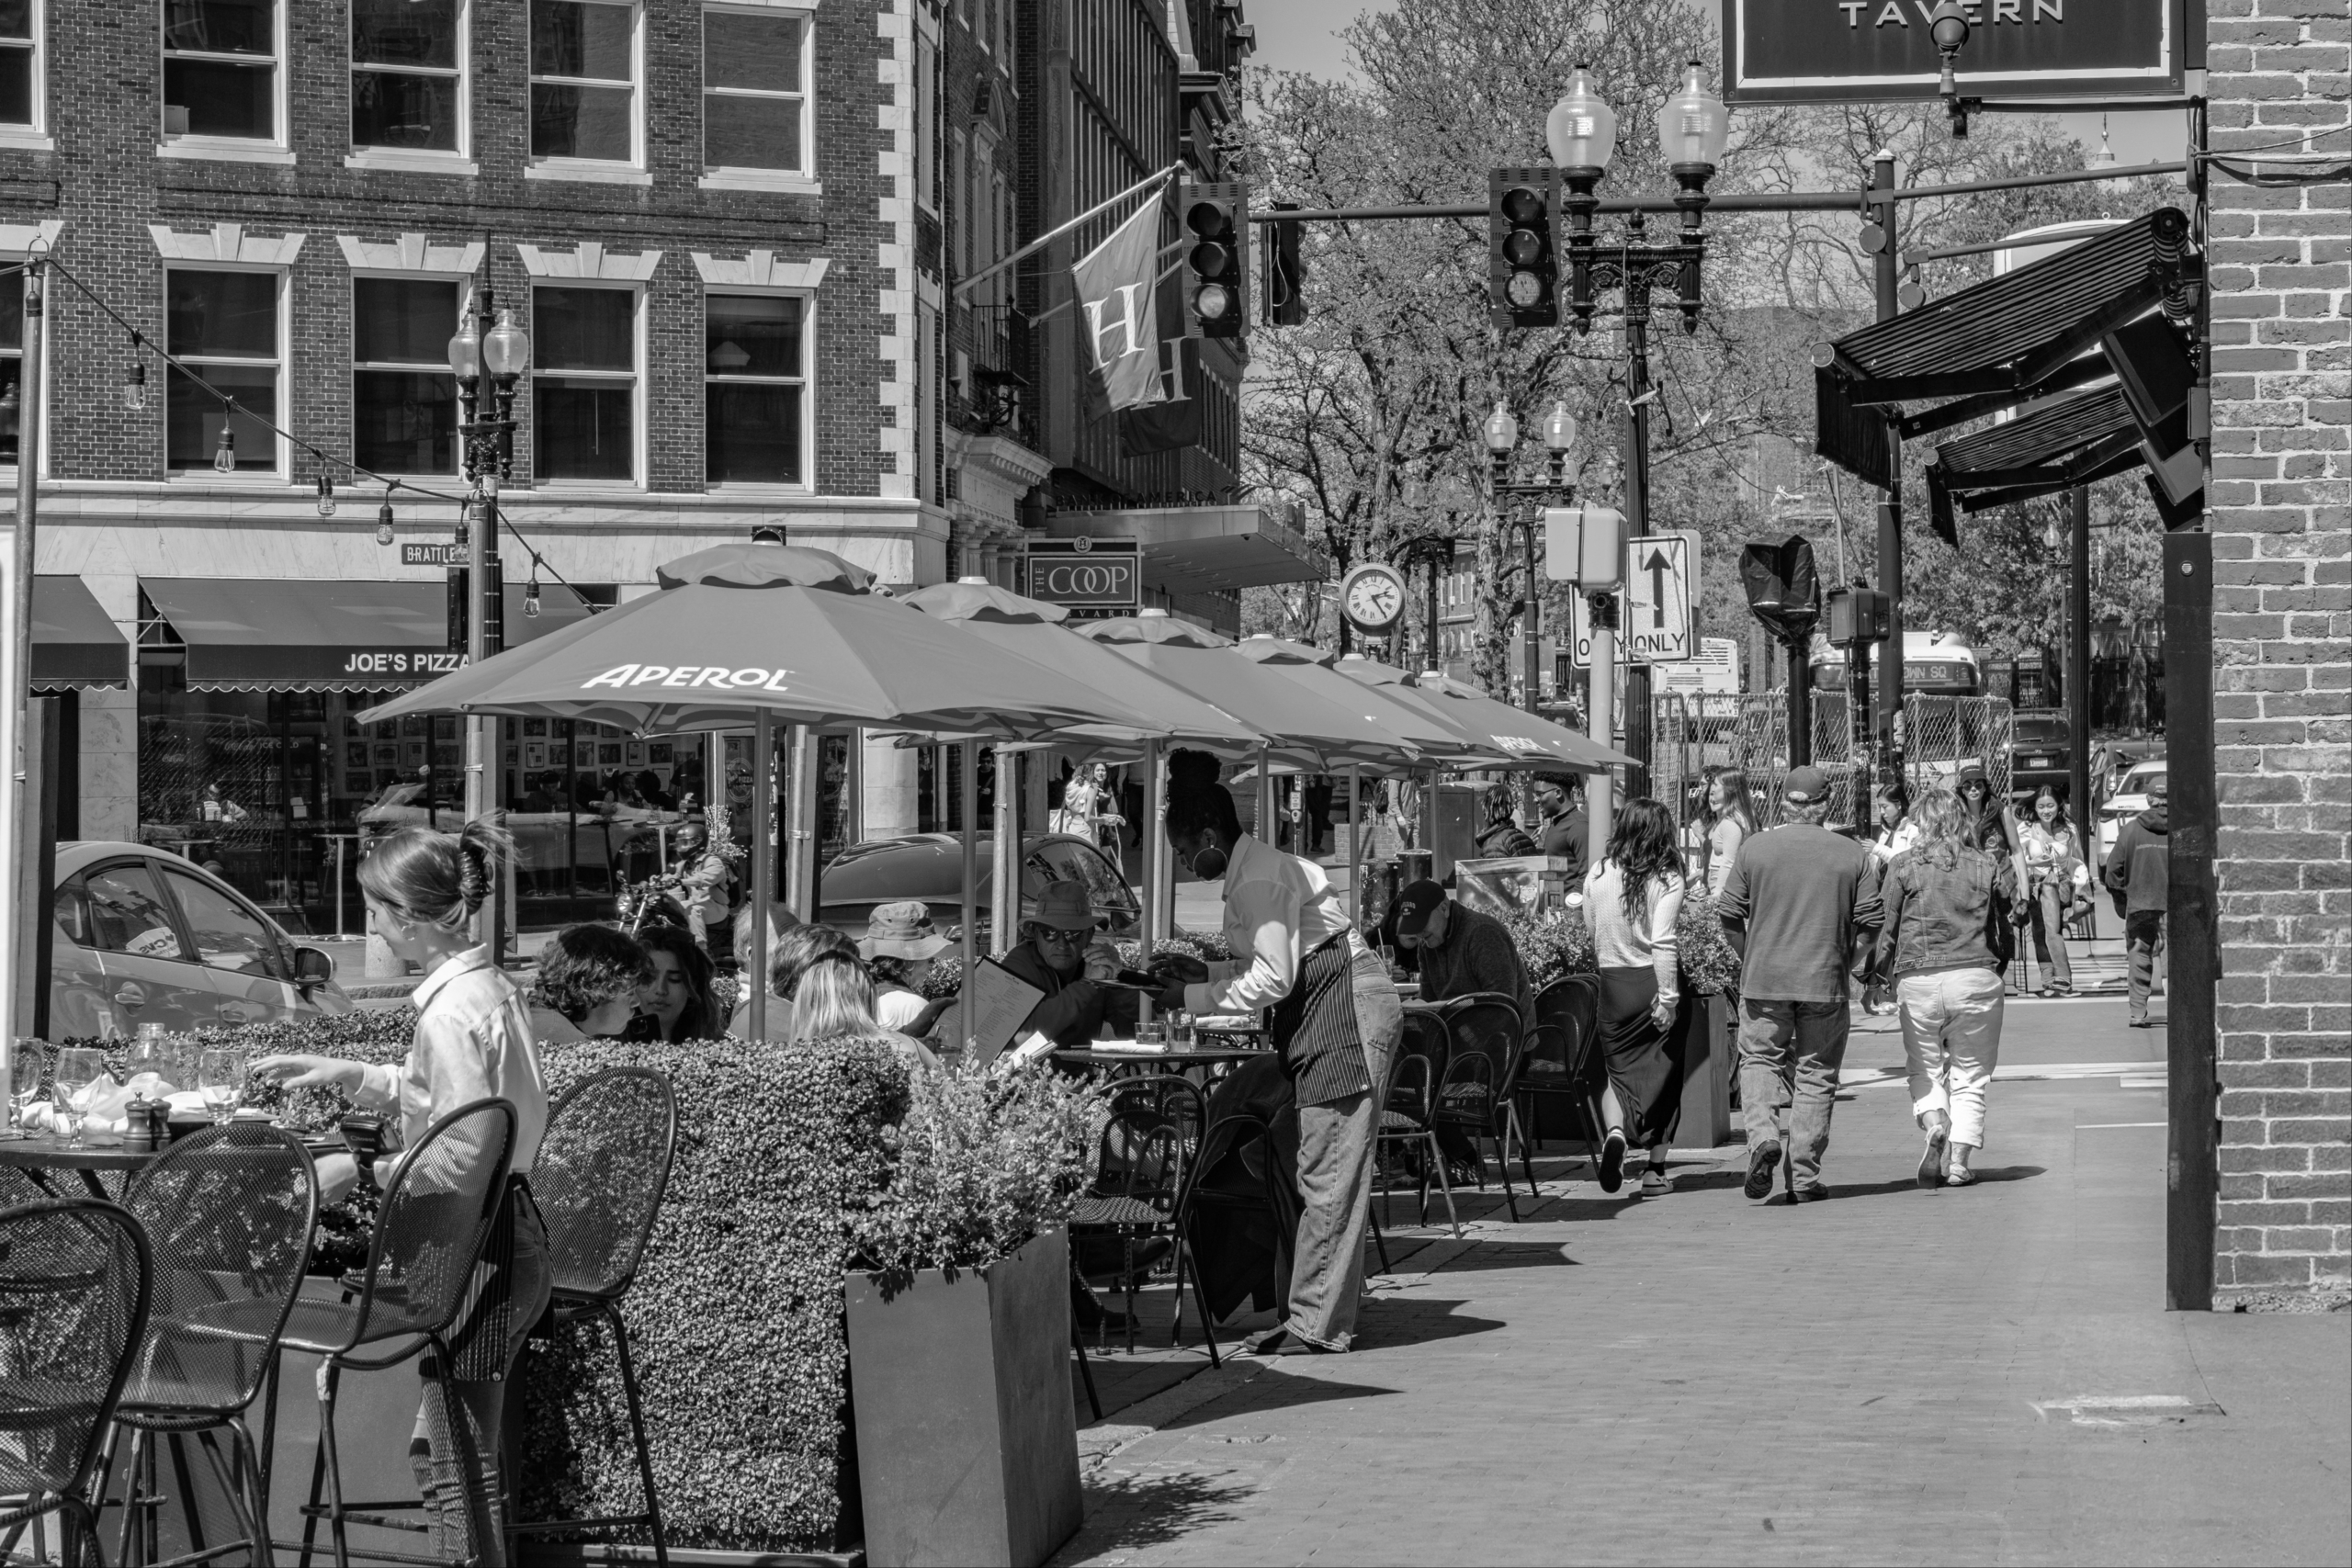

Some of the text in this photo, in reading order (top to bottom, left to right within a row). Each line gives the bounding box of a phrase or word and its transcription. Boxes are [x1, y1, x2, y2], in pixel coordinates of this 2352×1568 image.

[1838, 0, 2064, 28] TAVERN
[1082, 281, 1145, 375] H
[1056, 491, 1217, 505] BANK OF AMERICA
[407, 547, 456, 562] BRATTLE
[1035, 567, 1045, 594] THE
[1048, 566, 1129, 594] COOP
[1634, 632, 1685, 653] ONLY
[413, 653, 469, 671] PIZZA
[580, 663, 788, 692] APEROL
